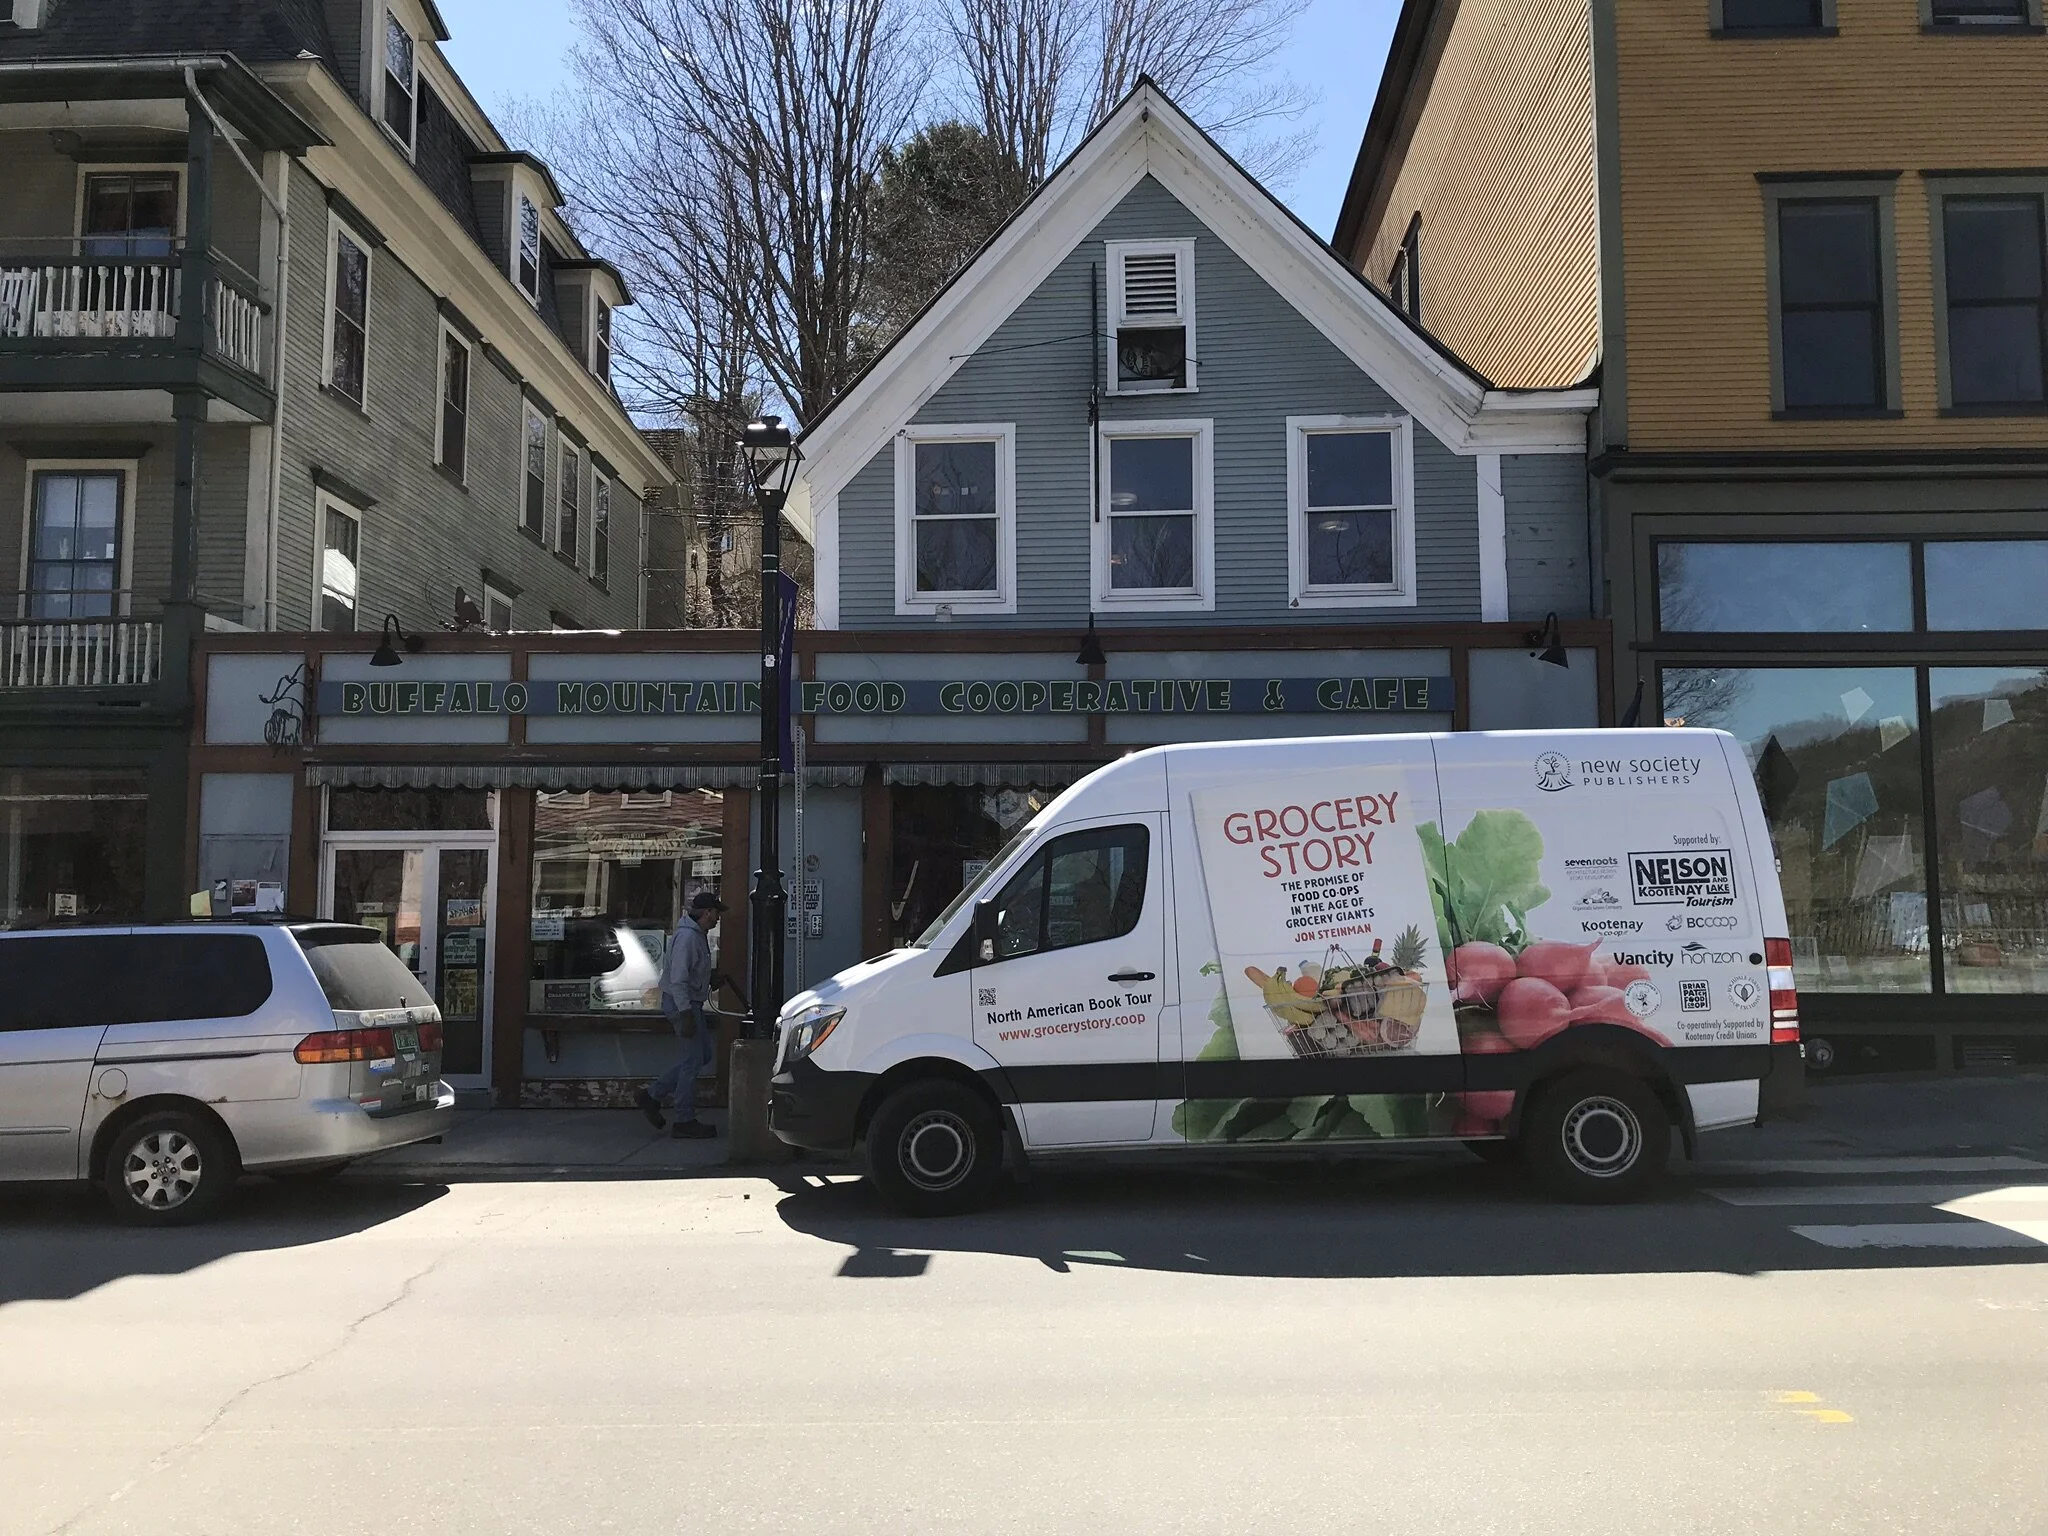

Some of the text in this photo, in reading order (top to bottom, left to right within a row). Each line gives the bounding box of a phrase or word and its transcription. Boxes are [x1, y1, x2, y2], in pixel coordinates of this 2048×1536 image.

[342, 678, 1430, 713] BUFFALO MOUNTAIN FOOD COOPERATIVE & CAFE
[1581, 756, 1701, 777] new society
[1584, 776, 1691, 786] PUBLISHERS
[1224, 791, 1398, 844] GROCERY
[1673, 834, 1708, 846] Supported
[1260, 831, 1375, 878] STORY
[1635, 857, 1727, 886] NELSON
[1281, 872, 1364, 892] THE PROMISE OF
[1638, 884, 1730, 897] KOOTENAY LAKE
[1292, 890, 1320, 902] FOOD
[1686, 896, 1734, 907] Tourism
[1291, 897, 1364, 915] IN THE AGE OF
[1286, 908, 1374, 928] GROCERY GIANTS
[1582, 920, 1644, 932] Kootenay
[1294, 924, 1372, 942] JON STEINMAN
[1614, 950, 1674, 967] Vancity
[1681, 950, 1743, 964] horizon
[988, 992, 1152, 1024] North American Book Tour
[999, 1013, 1146, 1041] www.grocerystory.coop
[1724, 1018, 1755, 1029] Supported
[1757, 1018, 1764, 1029] by
[1686, 1031, 1757, 1040] Kootenay Credit Unions
